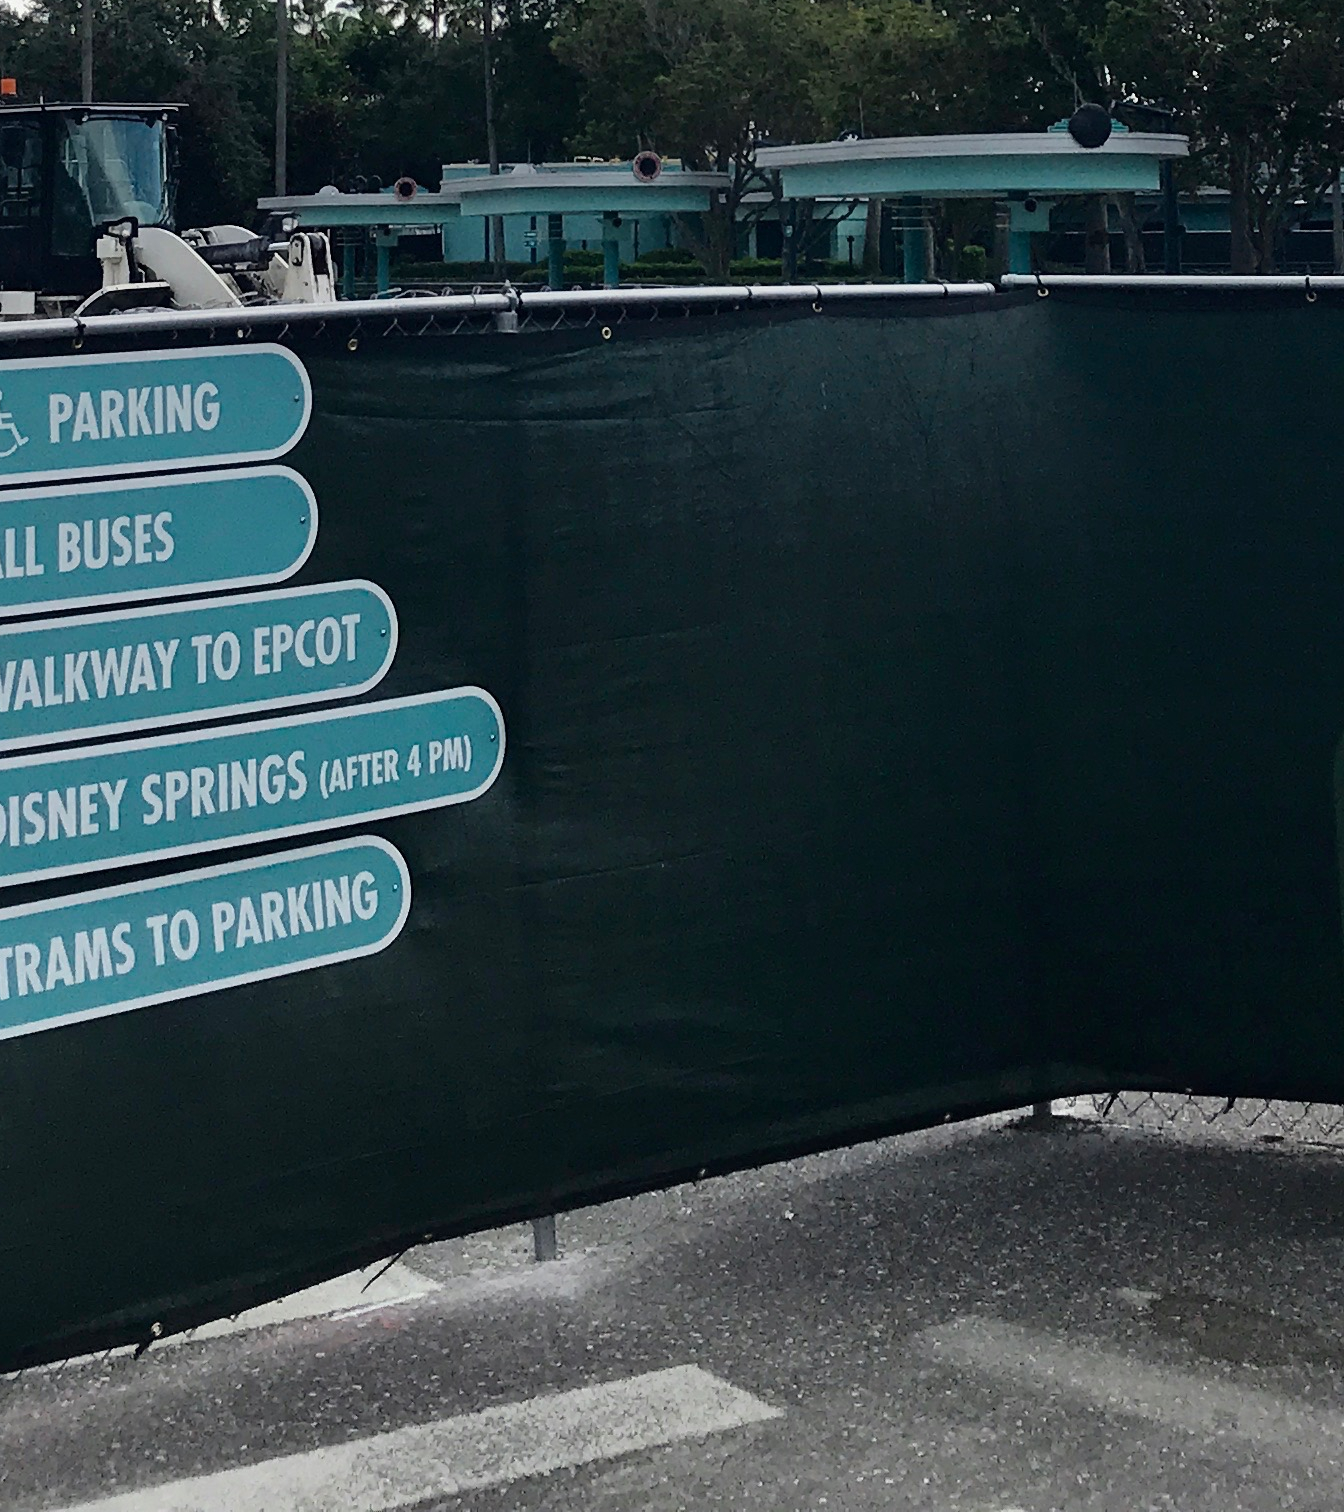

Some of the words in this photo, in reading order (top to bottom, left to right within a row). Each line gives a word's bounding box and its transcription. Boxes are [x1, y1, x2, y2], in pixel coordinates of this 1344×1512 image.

[49, 382, 221, 444] PARKING
[58, 511, 175, 573] BUSES
[191, 632, 241, 684] TO
[254, 613, 361, 675] EPCOT
[141, 750, 308, 825] SPRINGS
[319, 749, 400, 799] (AFTER
[407, 744, 422, 777] 4
[429, 734, 472, 774] PM)
[145, 909, 200, 966] TO
[211, 870, 379, 953] PARKING
